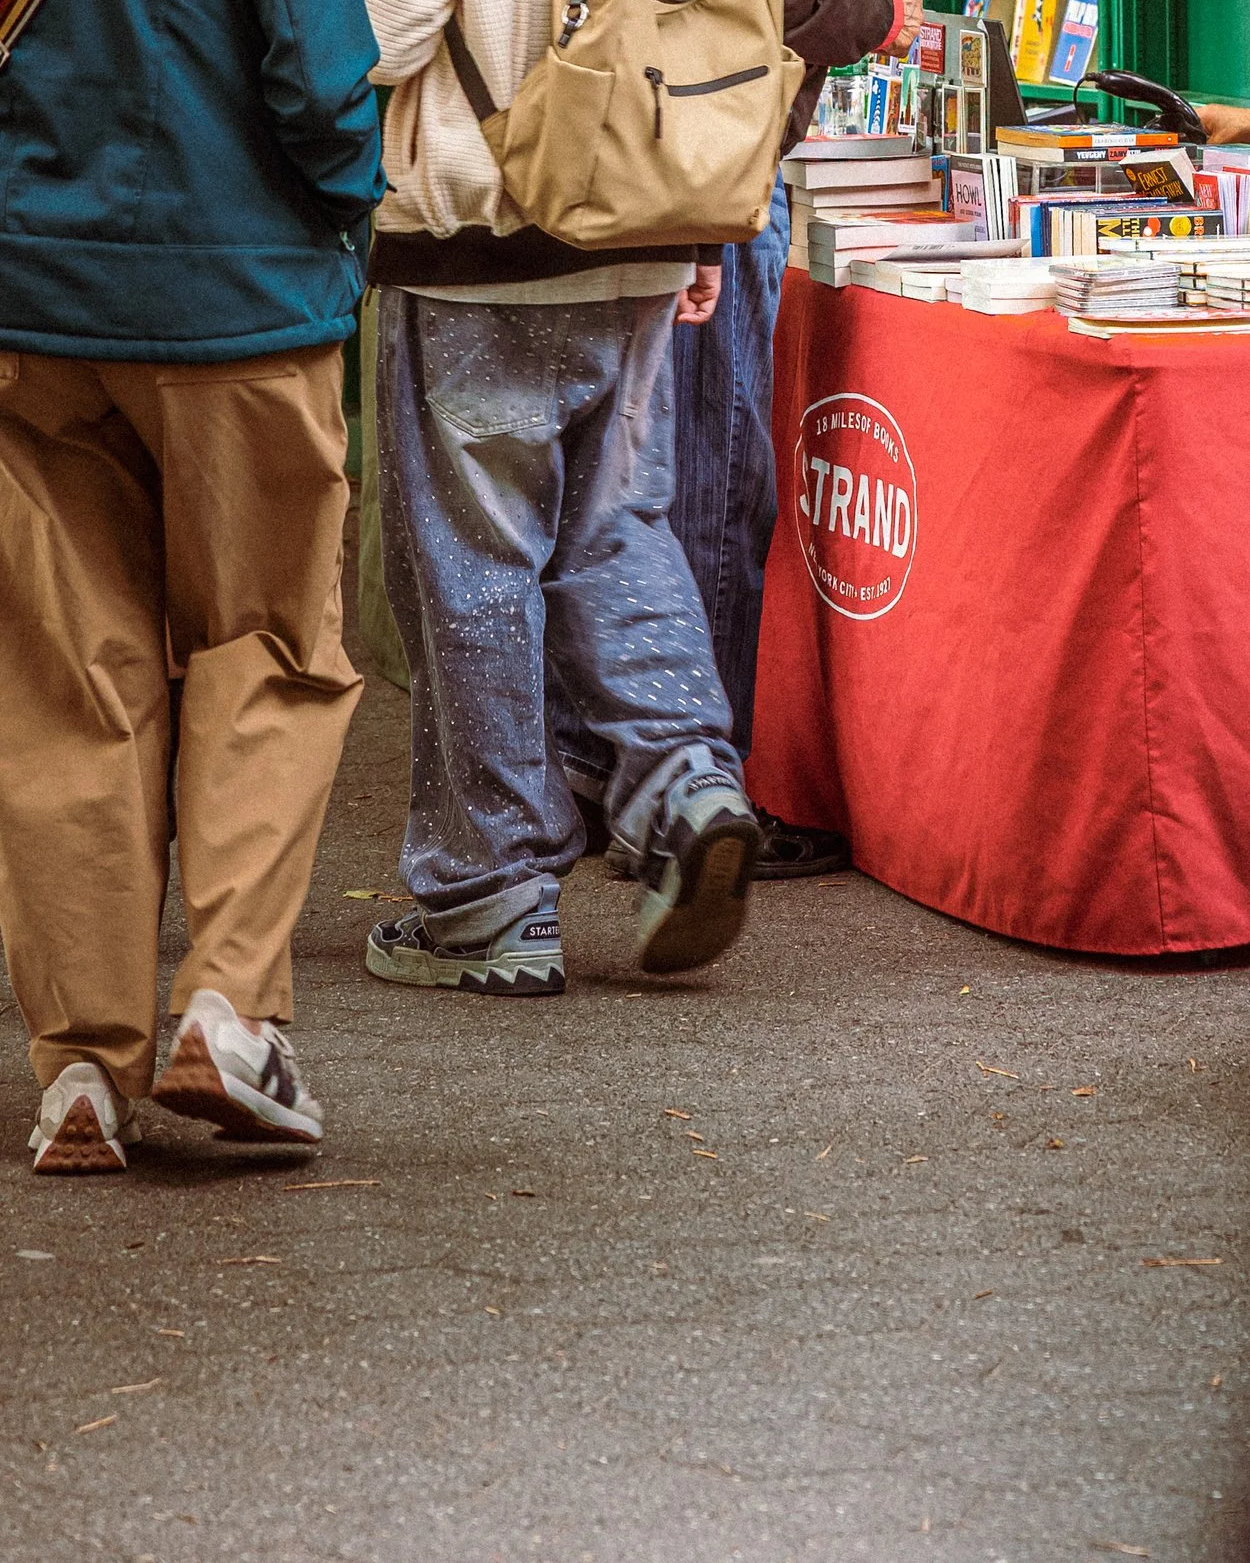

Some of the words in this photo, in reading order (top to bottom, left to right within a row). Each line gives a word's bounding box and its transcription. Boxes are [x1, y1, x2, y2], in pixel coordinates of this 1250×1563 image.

[1076, 150, 1107, 160] YEVGENY
[1137, 167, 1168, 192] ERNEST
[955, 183, 982, 206] HOWL
[816, 416, 828, 436] 18
[831, 411, 861, 430] MILES
[861, 414, 872, 435] OF
[873, 421, 900, 464] BOOKS
[876, 576, 891, 598] 1927
[529, 926, 560, 937] STARTE
